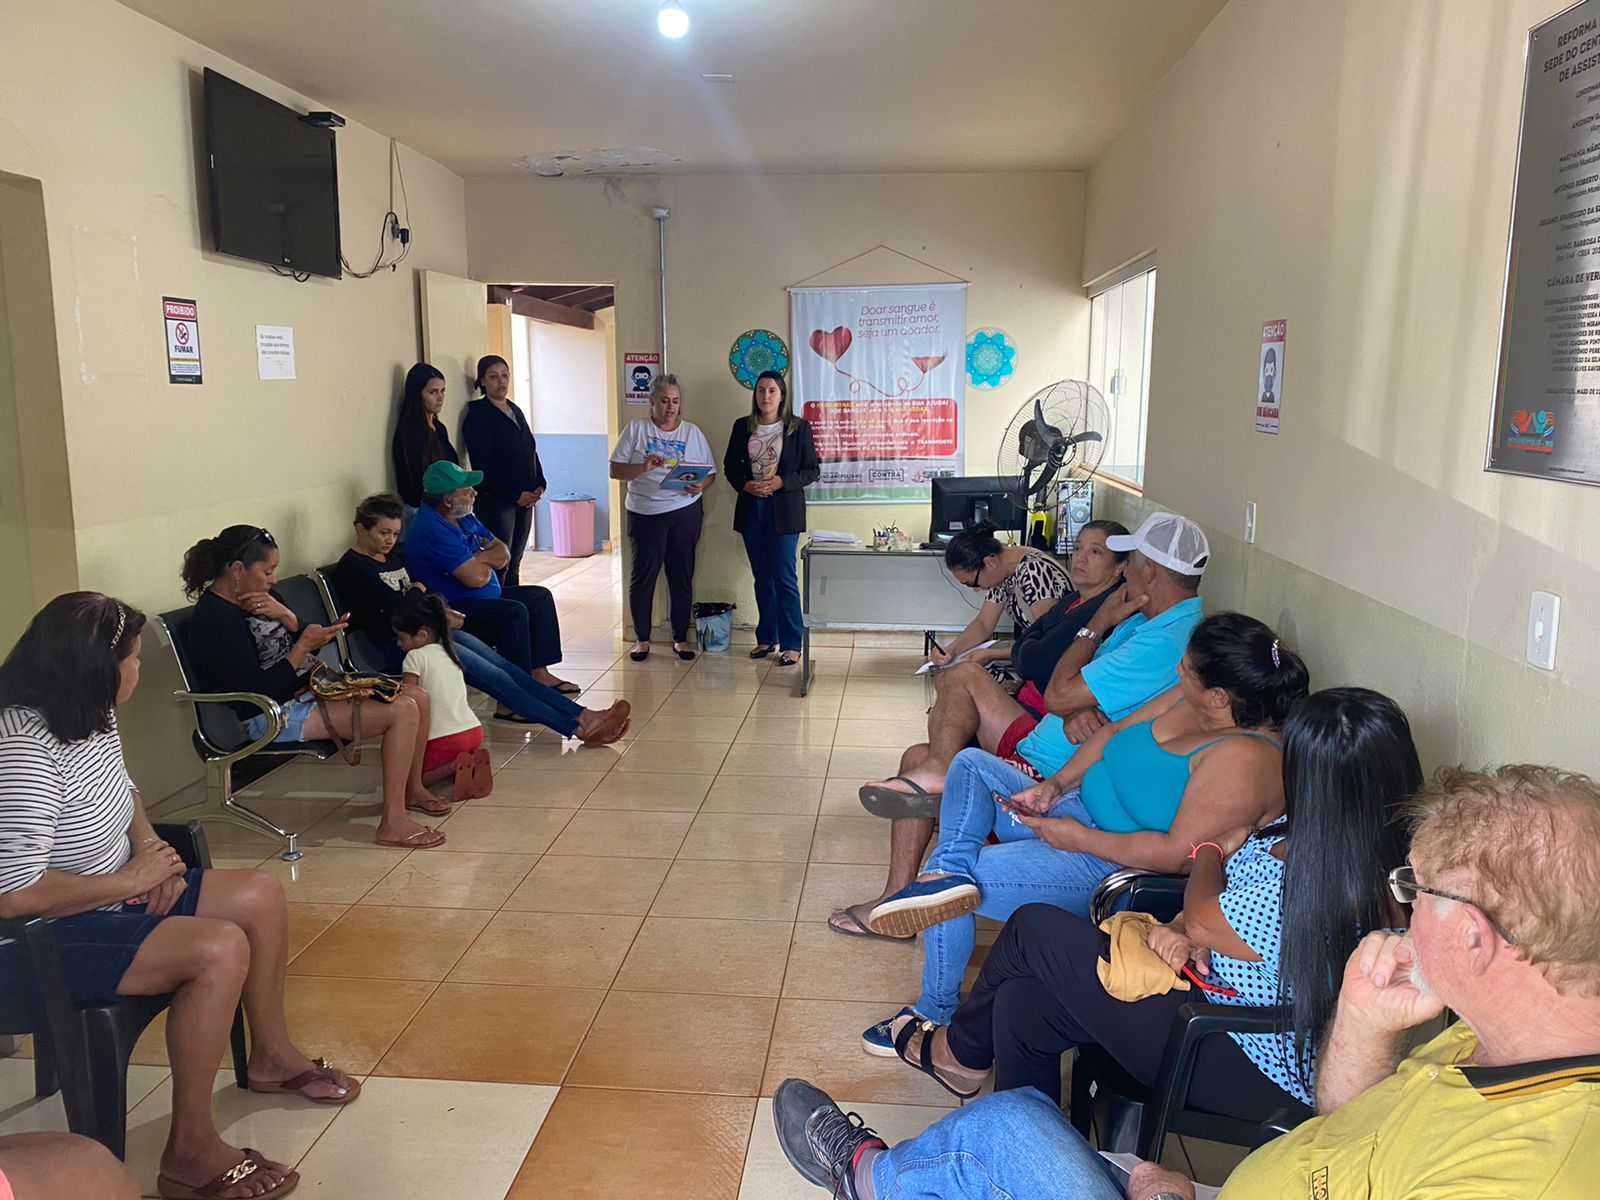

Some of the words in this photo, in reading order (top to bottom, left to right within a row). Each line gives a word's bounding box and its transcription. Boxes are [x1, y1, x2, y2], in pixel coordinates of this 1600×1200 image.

[1556, 18, 1597, 48] REFORMA
[1543, 53, 1564, 73] SEDE
[1565, 46, 1578, 62] DO
[1559, 67, 1570, 83] DE
[1575, 174, 1598, 187] ROBERTO
[1587, 206, 1595, 215] DA
[1573, 237, 1596, 248] BARBOSA
[1577, 248, 1590, 257] CREA
[1547, 275, 1574, 287] CÂMARA
[1575, 272, 1585, 283] DE
[1580, 293, 1598, 302] BORGES
[166, 304, 195, 316] PROIBIDO
[861, 305, 886, 316] Doar
[888, 303, 927, 315] sangue
[928, 299, 936, 311] é
[858, 315, 907, 327] transmitir
[909, 314, 939, 324] amor,
[858, 328, 878, 340] seja
[880, 329, 897, 337] um
[174, 345, 194, 354] FUMAR
[626, 354, 658, 362] ATENÇÃO
[1589, 387, 1595, 395] DE
[926, 398, 949, 406] AJUDA!
[917, 438, 952, 446] TRANSPORTE
[872, 470, 901, 478] CONTRA
